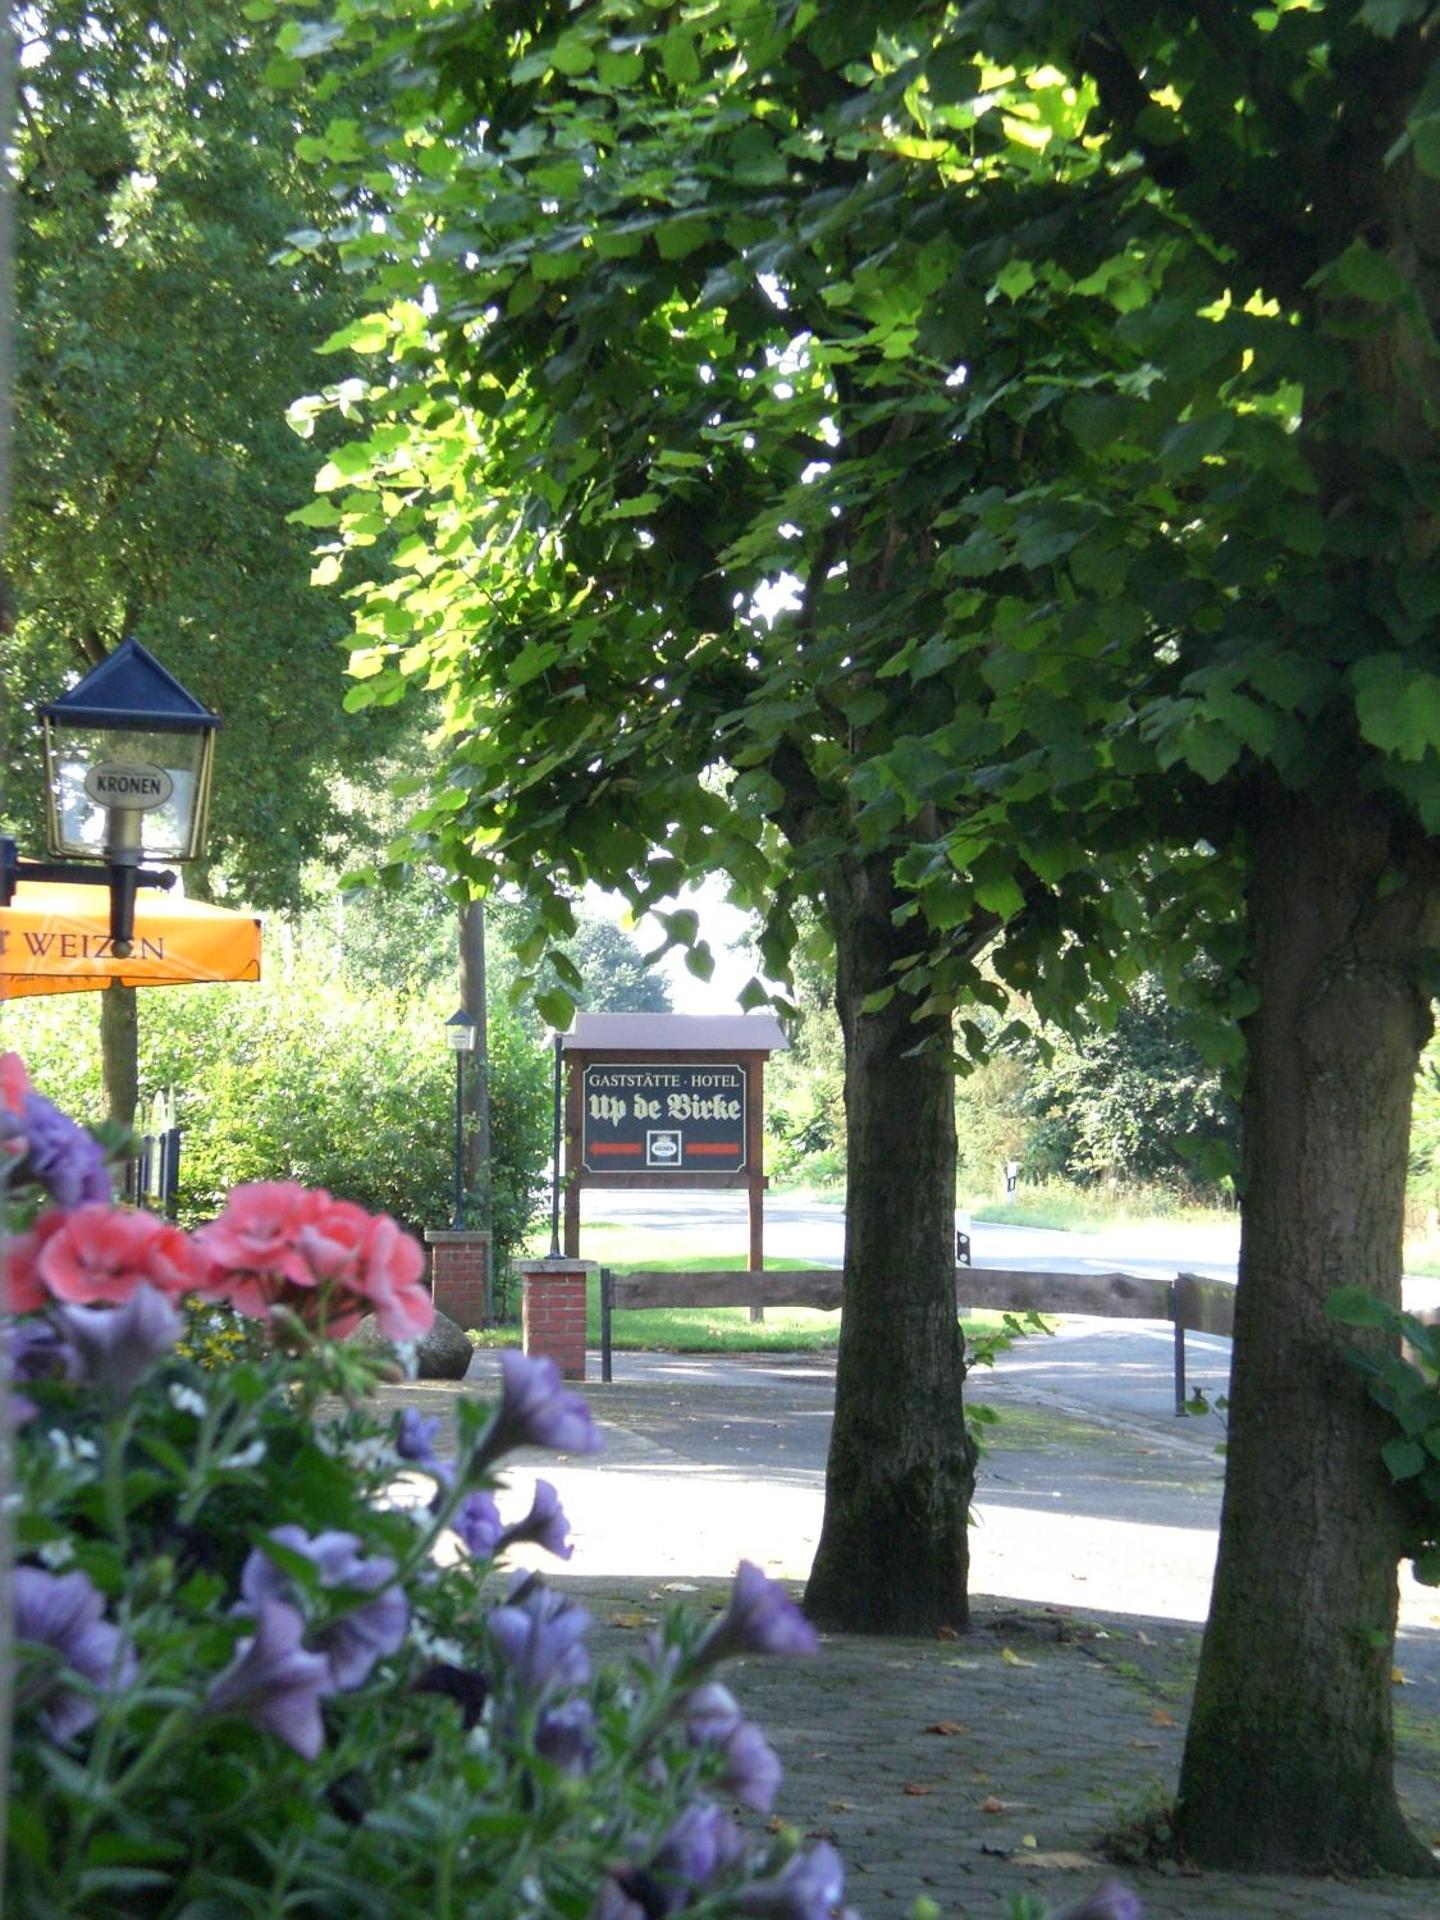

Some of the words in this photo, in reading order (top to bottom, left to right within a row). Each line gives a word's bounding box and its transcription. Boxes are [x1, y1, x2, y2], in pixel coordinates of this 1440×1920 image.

[96, 775, 161, 795] KRONEN
[589, 1072, 680, 1088] GASTSTÄTTE
[691, 1074, 740, 1088] HOTEL
[589, 1093, 627, 1127] Up
[633, 1093, 662, 1120] de
[666, 1093, 741, 1121] Birke
